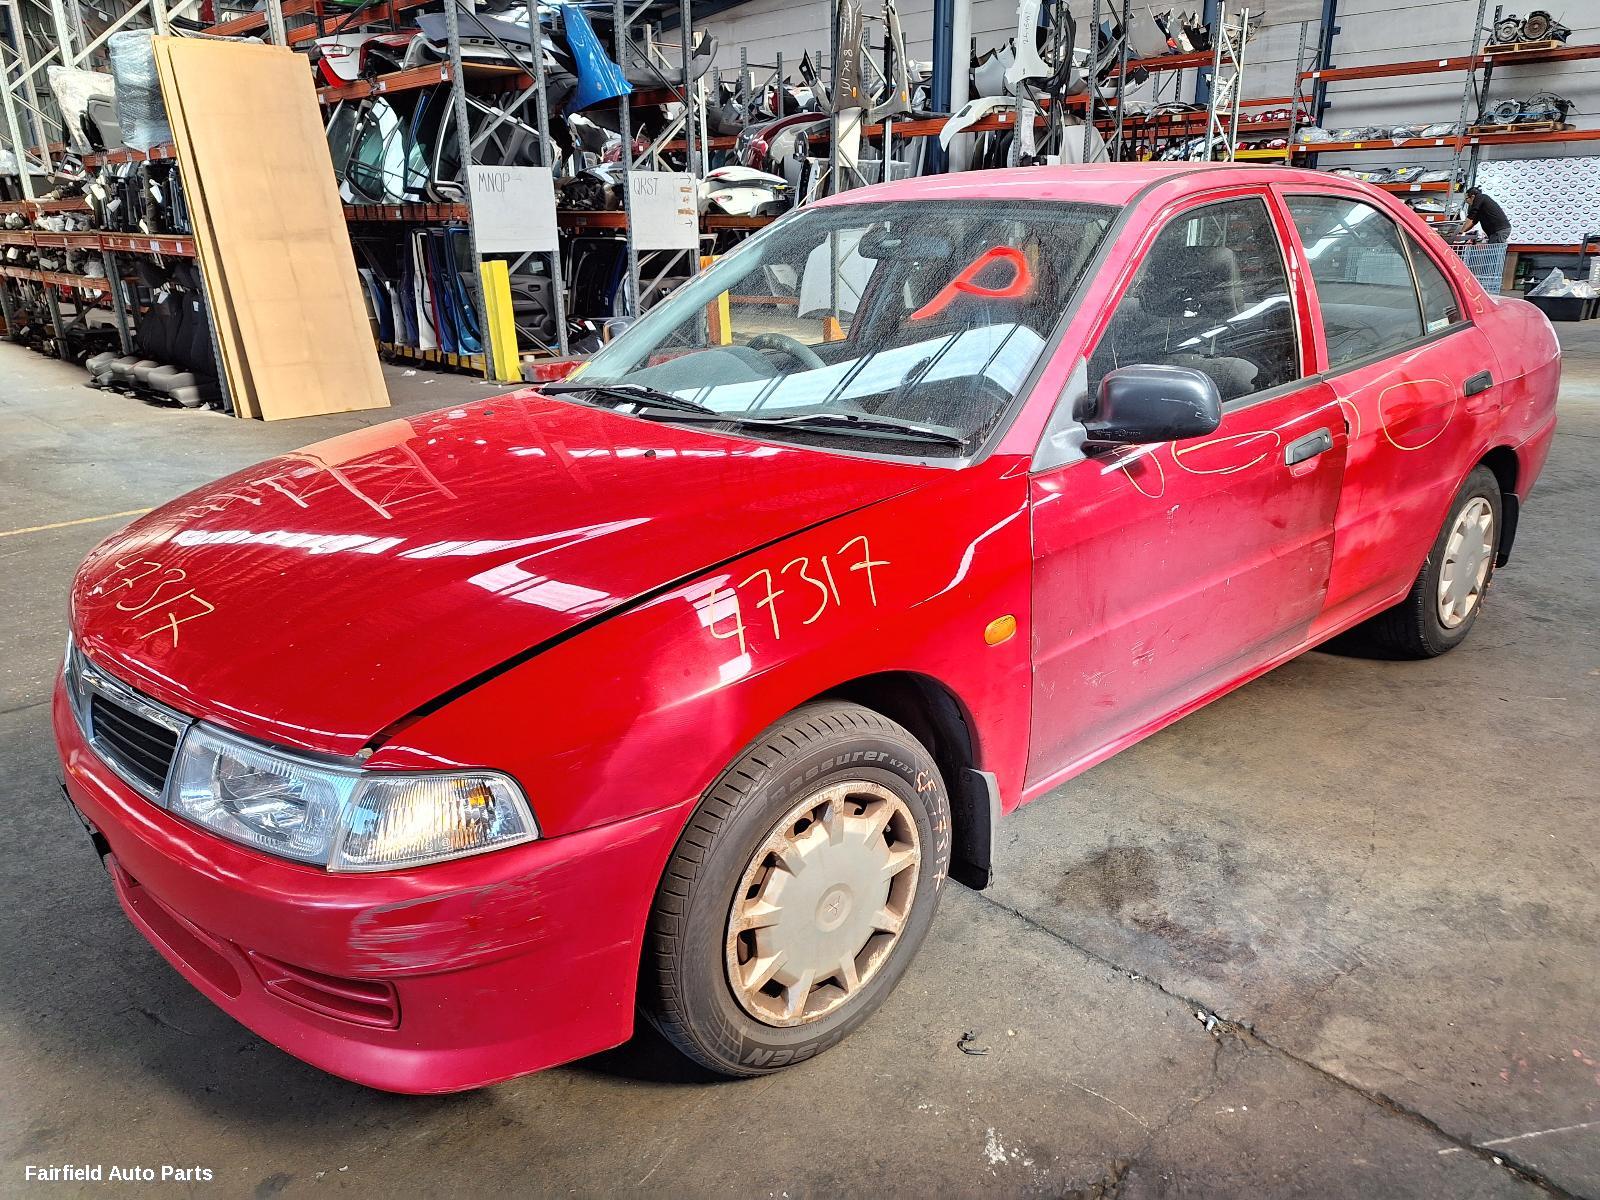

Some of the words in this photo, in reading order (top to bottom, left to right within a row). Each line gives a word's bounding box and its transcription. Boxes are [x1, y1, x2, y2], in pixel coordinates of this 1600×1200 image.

[478, 172, 511, 193] MNOP
[708, 535, 892, 656] 47317
[889, 758, 914, 774] K737
